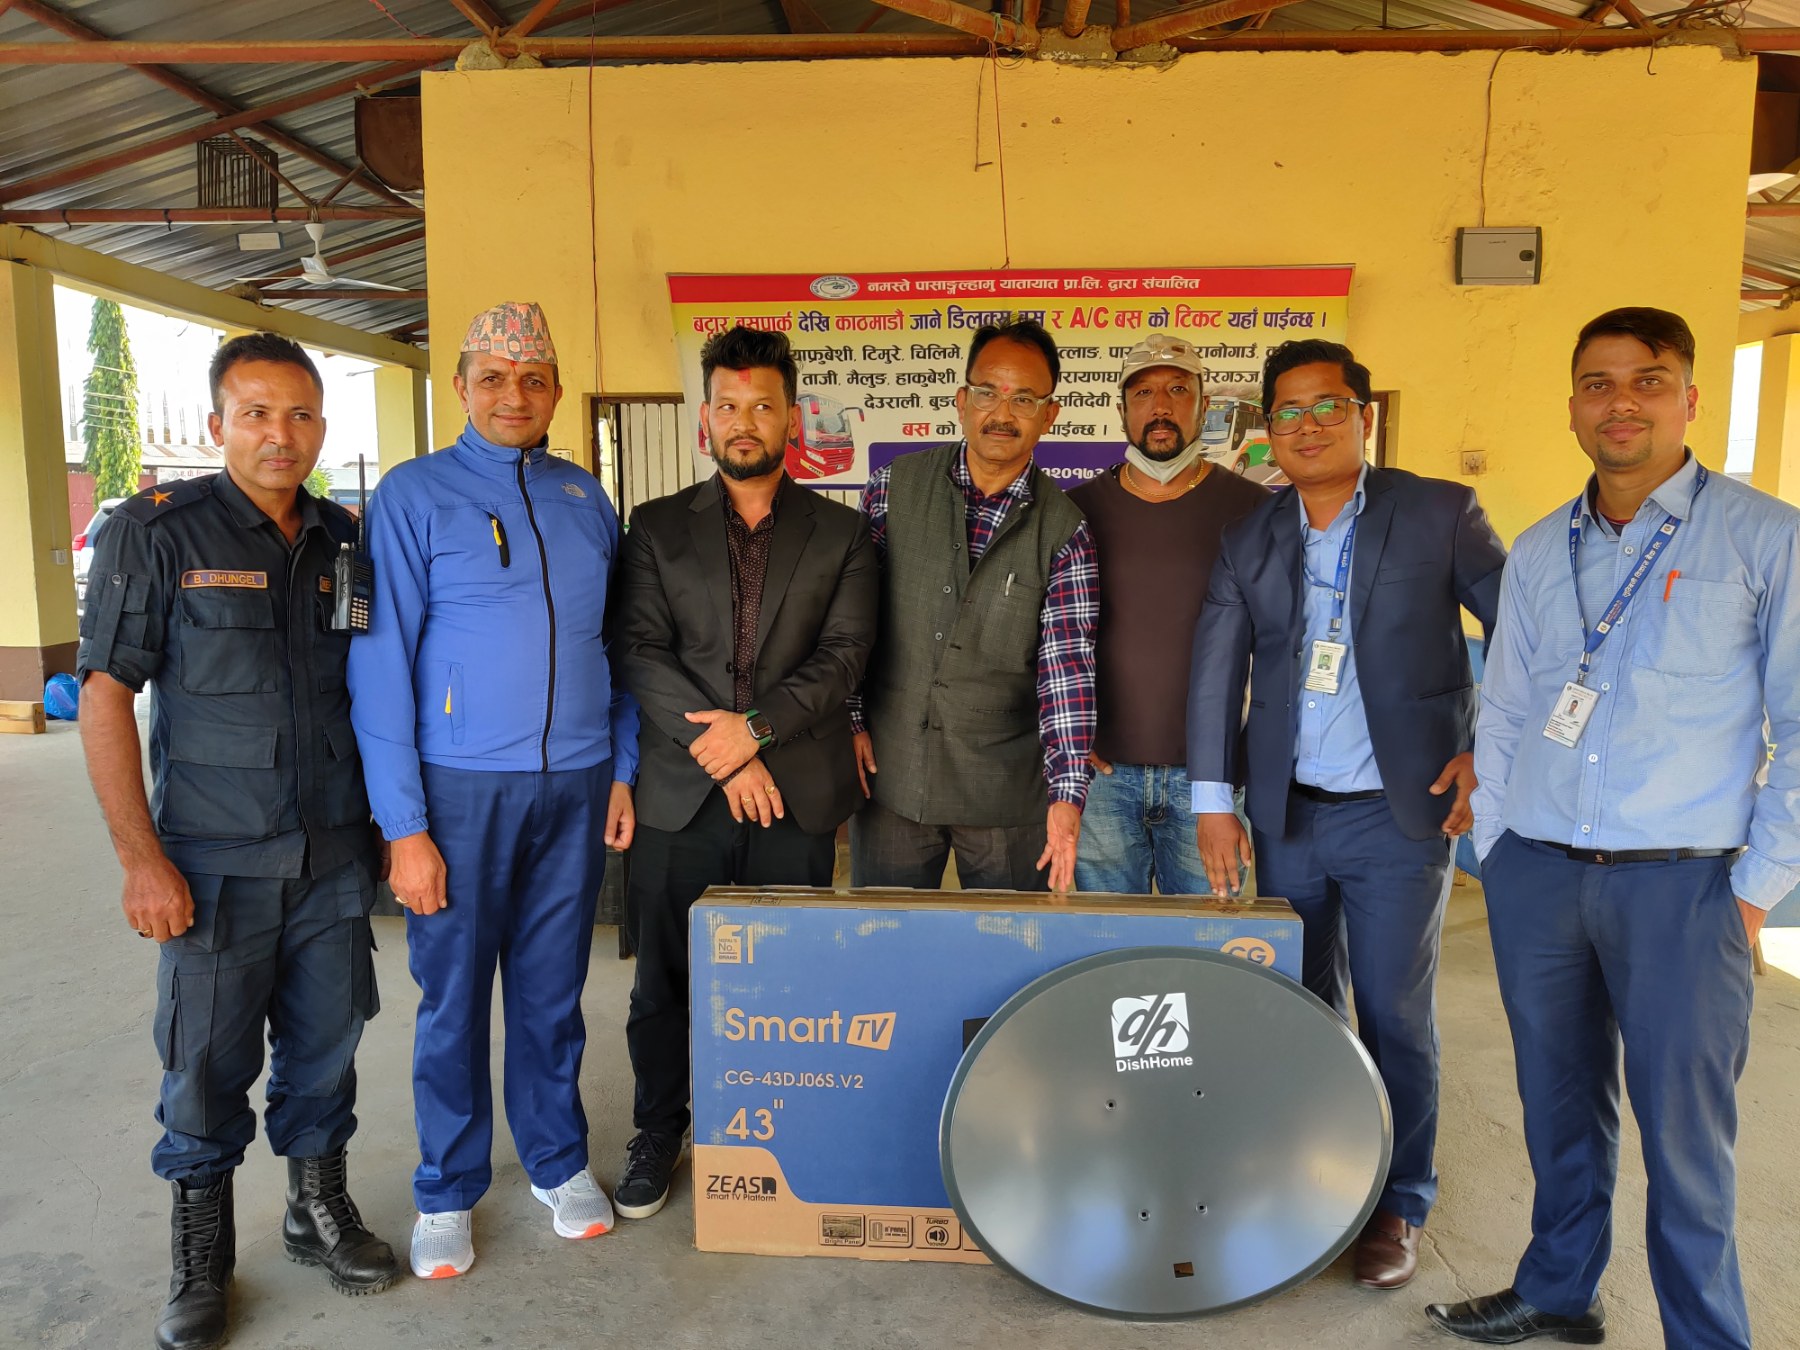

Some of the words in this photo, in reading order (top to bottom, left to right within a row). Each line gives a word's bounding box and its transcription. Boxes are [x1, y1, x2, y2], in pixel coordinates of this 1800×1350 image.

[867, 278, 910, 292] नमस्ते
[1000, 279, 1059, 290] यातायात
[1108, 278, 1138, 292] द्वारा
[1142, 275, 1201, 290] संचालित
[798, 310, 830, 332] देखि
[910, 309, 942, 330] जाने
[1051, 310, 1064, 329] र
[1069, 306, 1110, 329] A/C
[1114, 310, 1143, 330] बस
[1148, 307, 1170, 328] को
[1174, 303, 1223, 328] टिकट
[1227, 306, 1259, 329] यहाँ
[902, 422, 931, 437] बस
[935, 420, 957, 436] को
[193, 574, 205, 584] B.
[209, 573, 257, 585] DHUNGEL
[724, 1007, 843, 1044] Smart
[857, 1017, 890, 1043] TV
[1116, 1055, 1194, 1073] DishHome
[706, 1192, 729, 1200] Smart
[732, 1193, 741, 1201] TV
[743, 1193, 777, 1202] Platform
